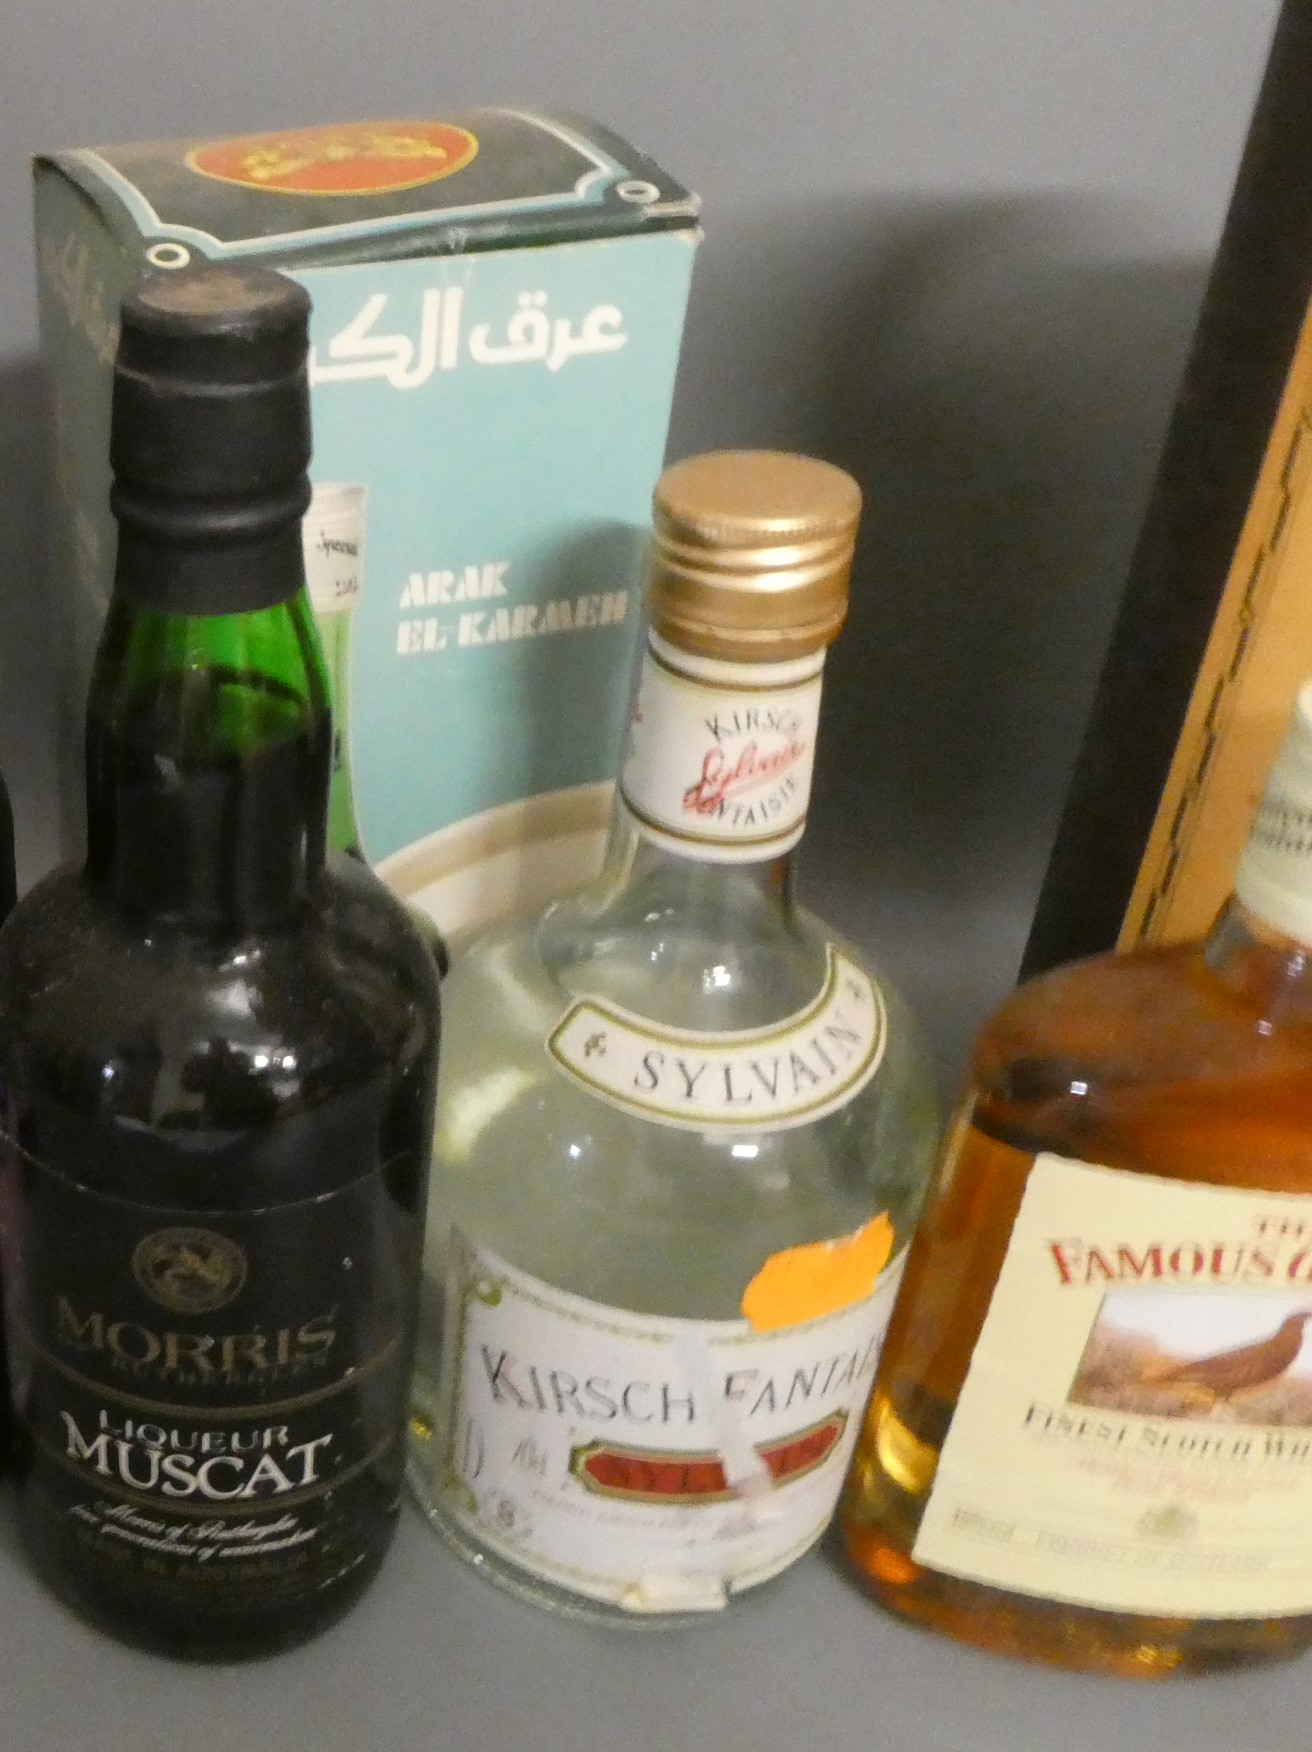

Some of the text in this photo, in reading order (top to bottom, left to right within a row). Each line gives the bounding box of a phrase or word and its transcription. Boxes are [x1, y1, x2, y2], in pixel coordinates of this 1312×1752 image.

[309, 286, 630, 390] عرق الك
[399, 560, 511, 611] ARAK
[396, 617, 448, 655] EL
[633, 1010, 862, 1103] SYLVAIN
[1255, 1214, 1312, 1237] TH
[1043, 1237, 1280, 1287] FAMOUS
[56, 1294, 340, 1379] MORRIS
[481, 1332, 884, 1424] KIRSCH FANTAI
[60, 1410, 334, 1500] MUSCAT
[99, 1409, 290, 1455] LIQUEUR
